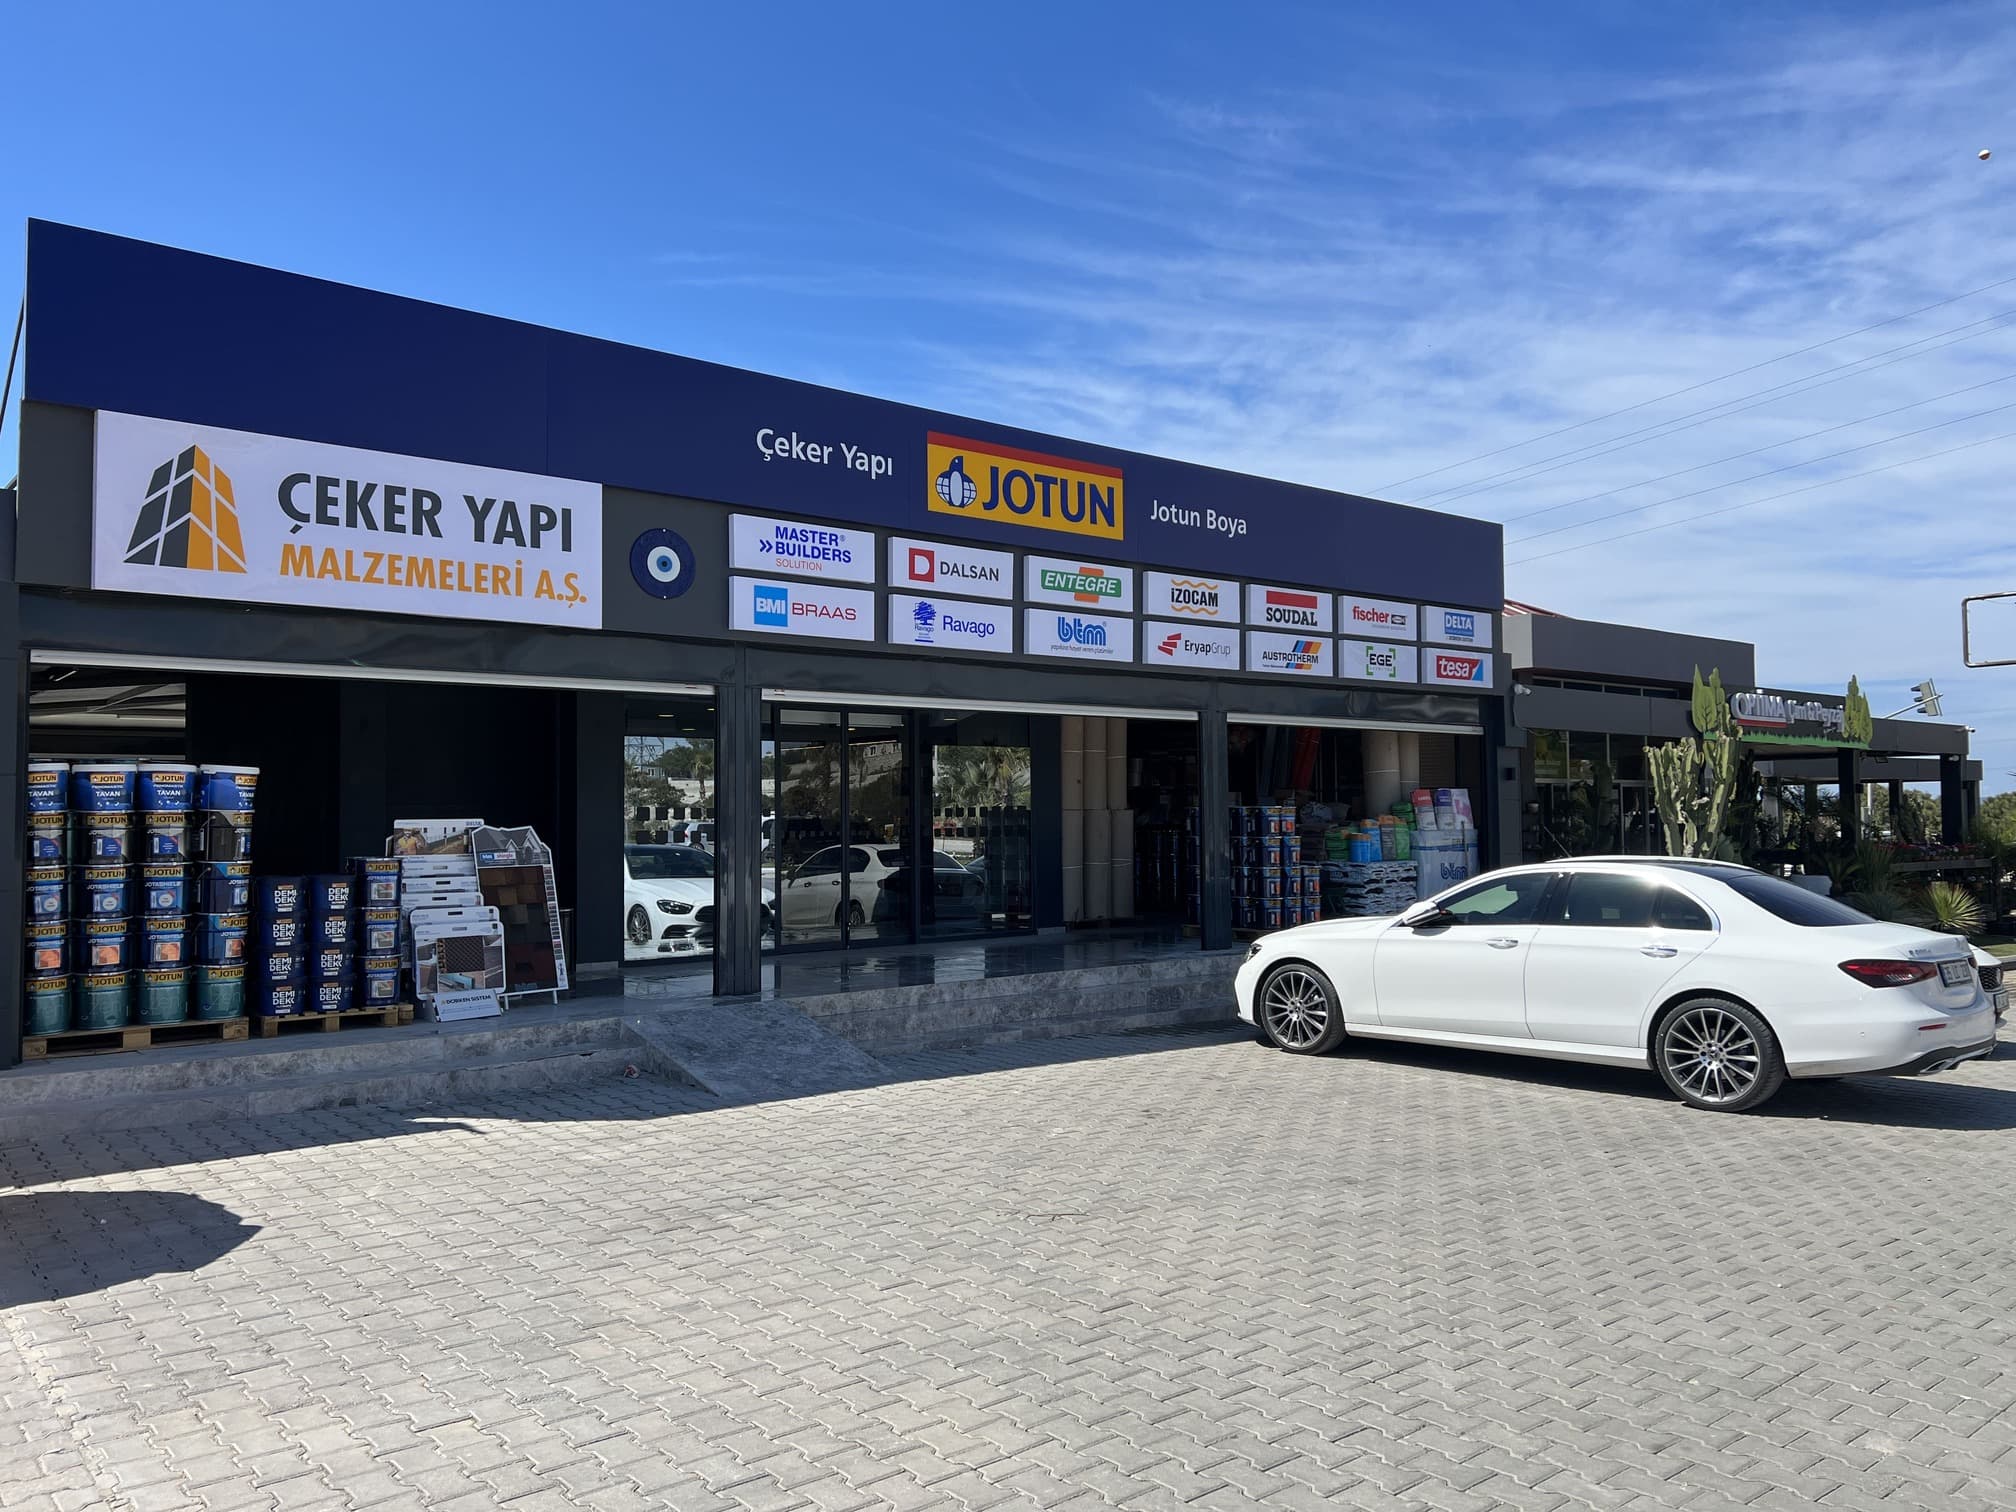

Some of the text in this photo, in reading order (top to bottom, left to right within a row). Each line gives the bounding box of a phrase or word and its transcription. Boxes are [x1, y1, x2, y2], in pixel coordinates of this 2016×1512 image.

[756, 428, 893, 479] Çeker Yapı
[982, 466, 1115, 528] JOTUN
[277, 472, 571, 552] ÇEKER YAPI
[1151, 500, 1247, 538] Jotun Boya
[775, 526, 839, 546] MASTER
[775, 542, 852, 564] BUILDERS
[776, 558, 823, 572] SOLUTION
[280, 544, 587, 608] MALZEMELERİ A.Ş.
[940, 561, 999, 582] DALSAN
[1044, 572, 1117, 594] ENTEGRE
[755, 597, 857, 621] BMI BRAAS
[1266, 607, 1318, 627] SOUDAL
[1353, 606, 1389, 624] fischer
[943, 615, 995, 638] Ravago
[1445, 614, 1472, 630] DELTA
[1057, 616, 1106, 647] btm
[1184, 639, 1231, 657] EryapGrup
[1262, 650, 1319, 665] AUSTROTHERM
[1369, 653, 1392, 667] EGE
[1438, 659, 1470, 679] tesa
[30, 774, 57, 783] JOTUN
[99, 774, 124, 783] JOTUN
[161, 774, 185, 782] JOTUN
[28, 790, 54, 798] TAVAN
[96, 790, 121, 798] TAVAN
[33, 816, 64, 825] JOTUN
[98, 816, 127, 825] JOTUN
[155, 815, 184, 823] JOTUN
[33, 870, 64, 880] JOTUN
[95, 869, 125, 879] JOTUN
[151, 867, 182, 877] JOTUN
[236, 866, 249, 875] JOT
[1440, 863, 1468, 880] btm
[96, 924, 126, 933] JOTUN
[156, 920, 185, 929] JOTUN
[273, 923, 295, 931] DEMI
[325, 920, 347, 928] DEMI
[35, 926, 65, 935] JOTUN
[269, 957, 292, 965] DEMI
[154, 973, 183, 982] JOTUN
[218, 969, 244, 978] JOTUN
[38, 979, 67, 989] JOTUN
[94, 976, 124, 986] JOTUN
